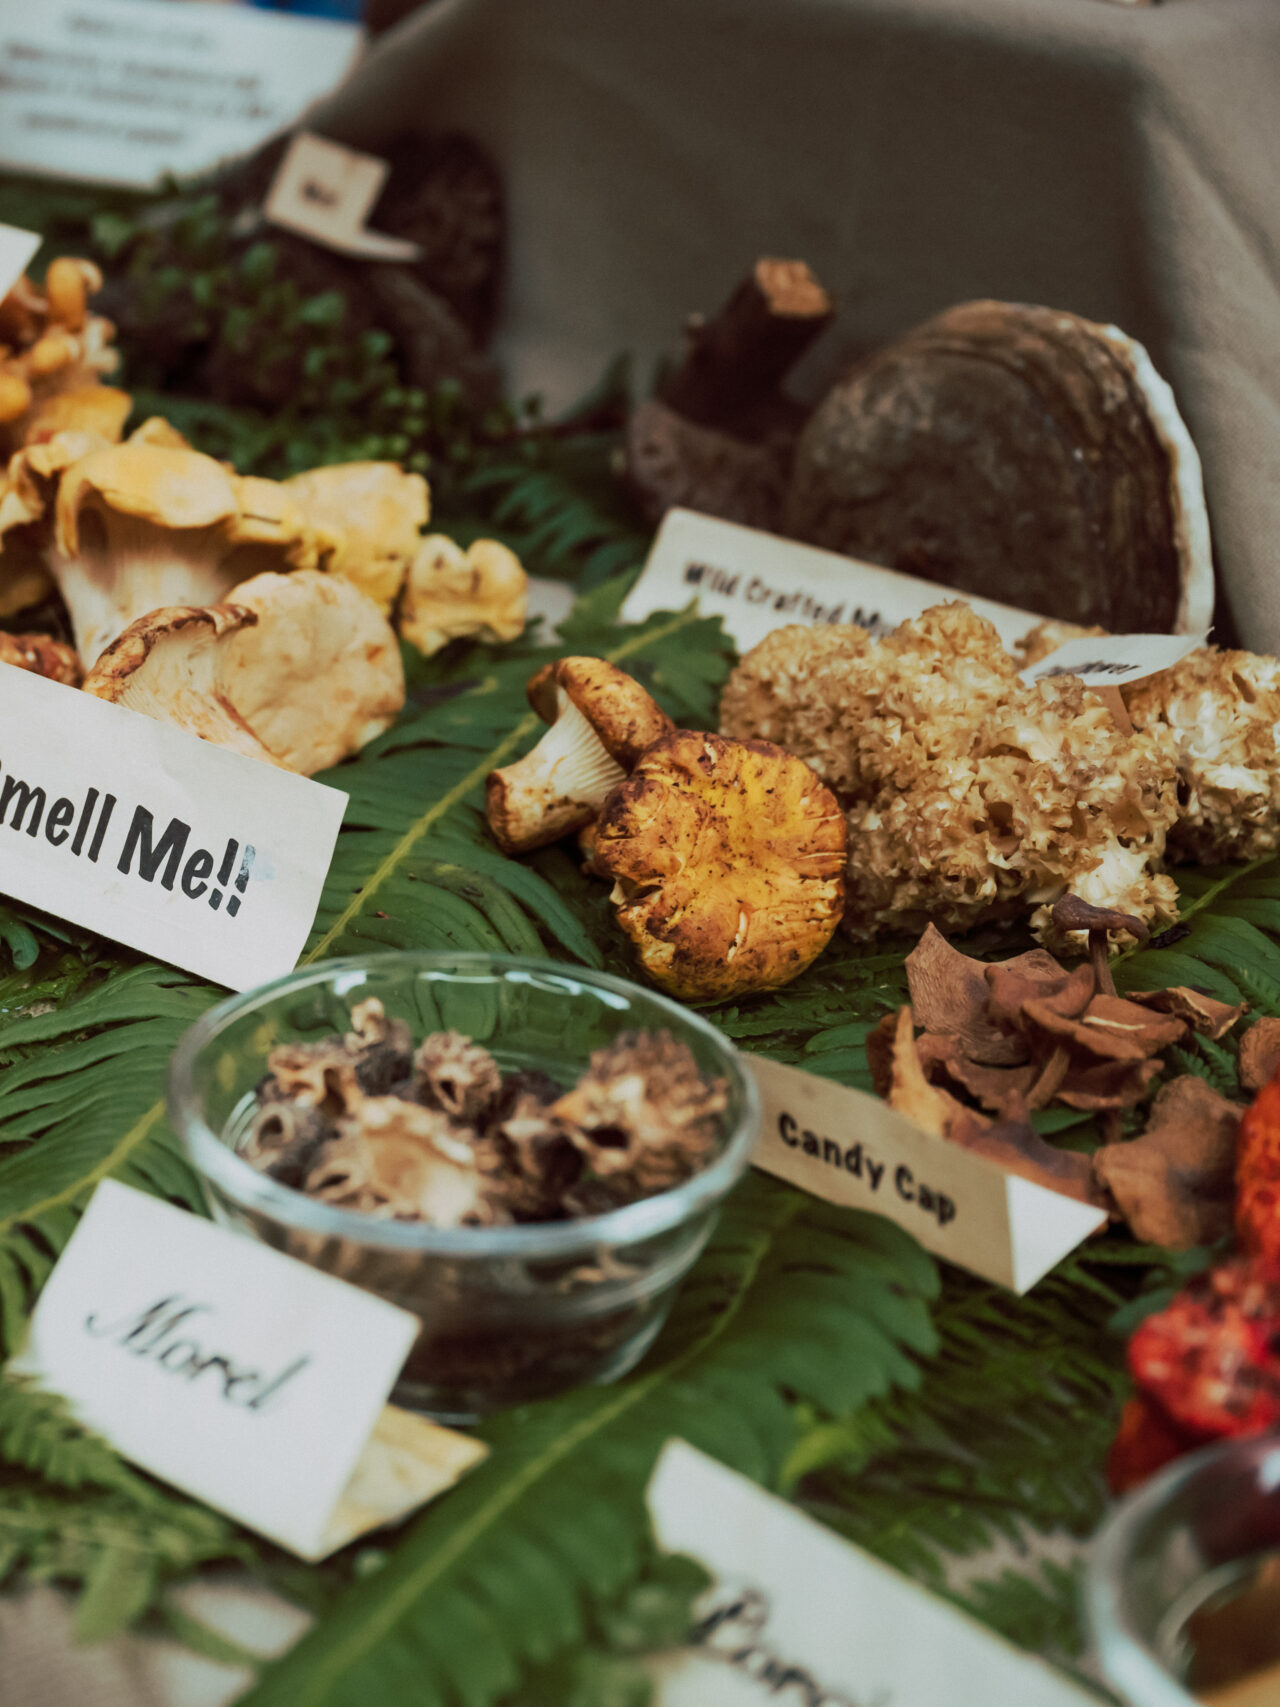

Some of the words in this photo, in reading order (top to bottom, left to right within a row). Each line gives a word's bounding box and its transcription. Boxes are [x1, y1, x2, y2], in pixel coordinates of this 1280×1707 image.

[683, 560, 740, 598] Wild
[745, 577, 844, 625] Crafted
[116, 804, 257, 918] Me!!
[777, 1110, 885, 1193] Candy
[894, 1163, 958, 1228] Cap
[84, 1294, 312, 1413] Morel
